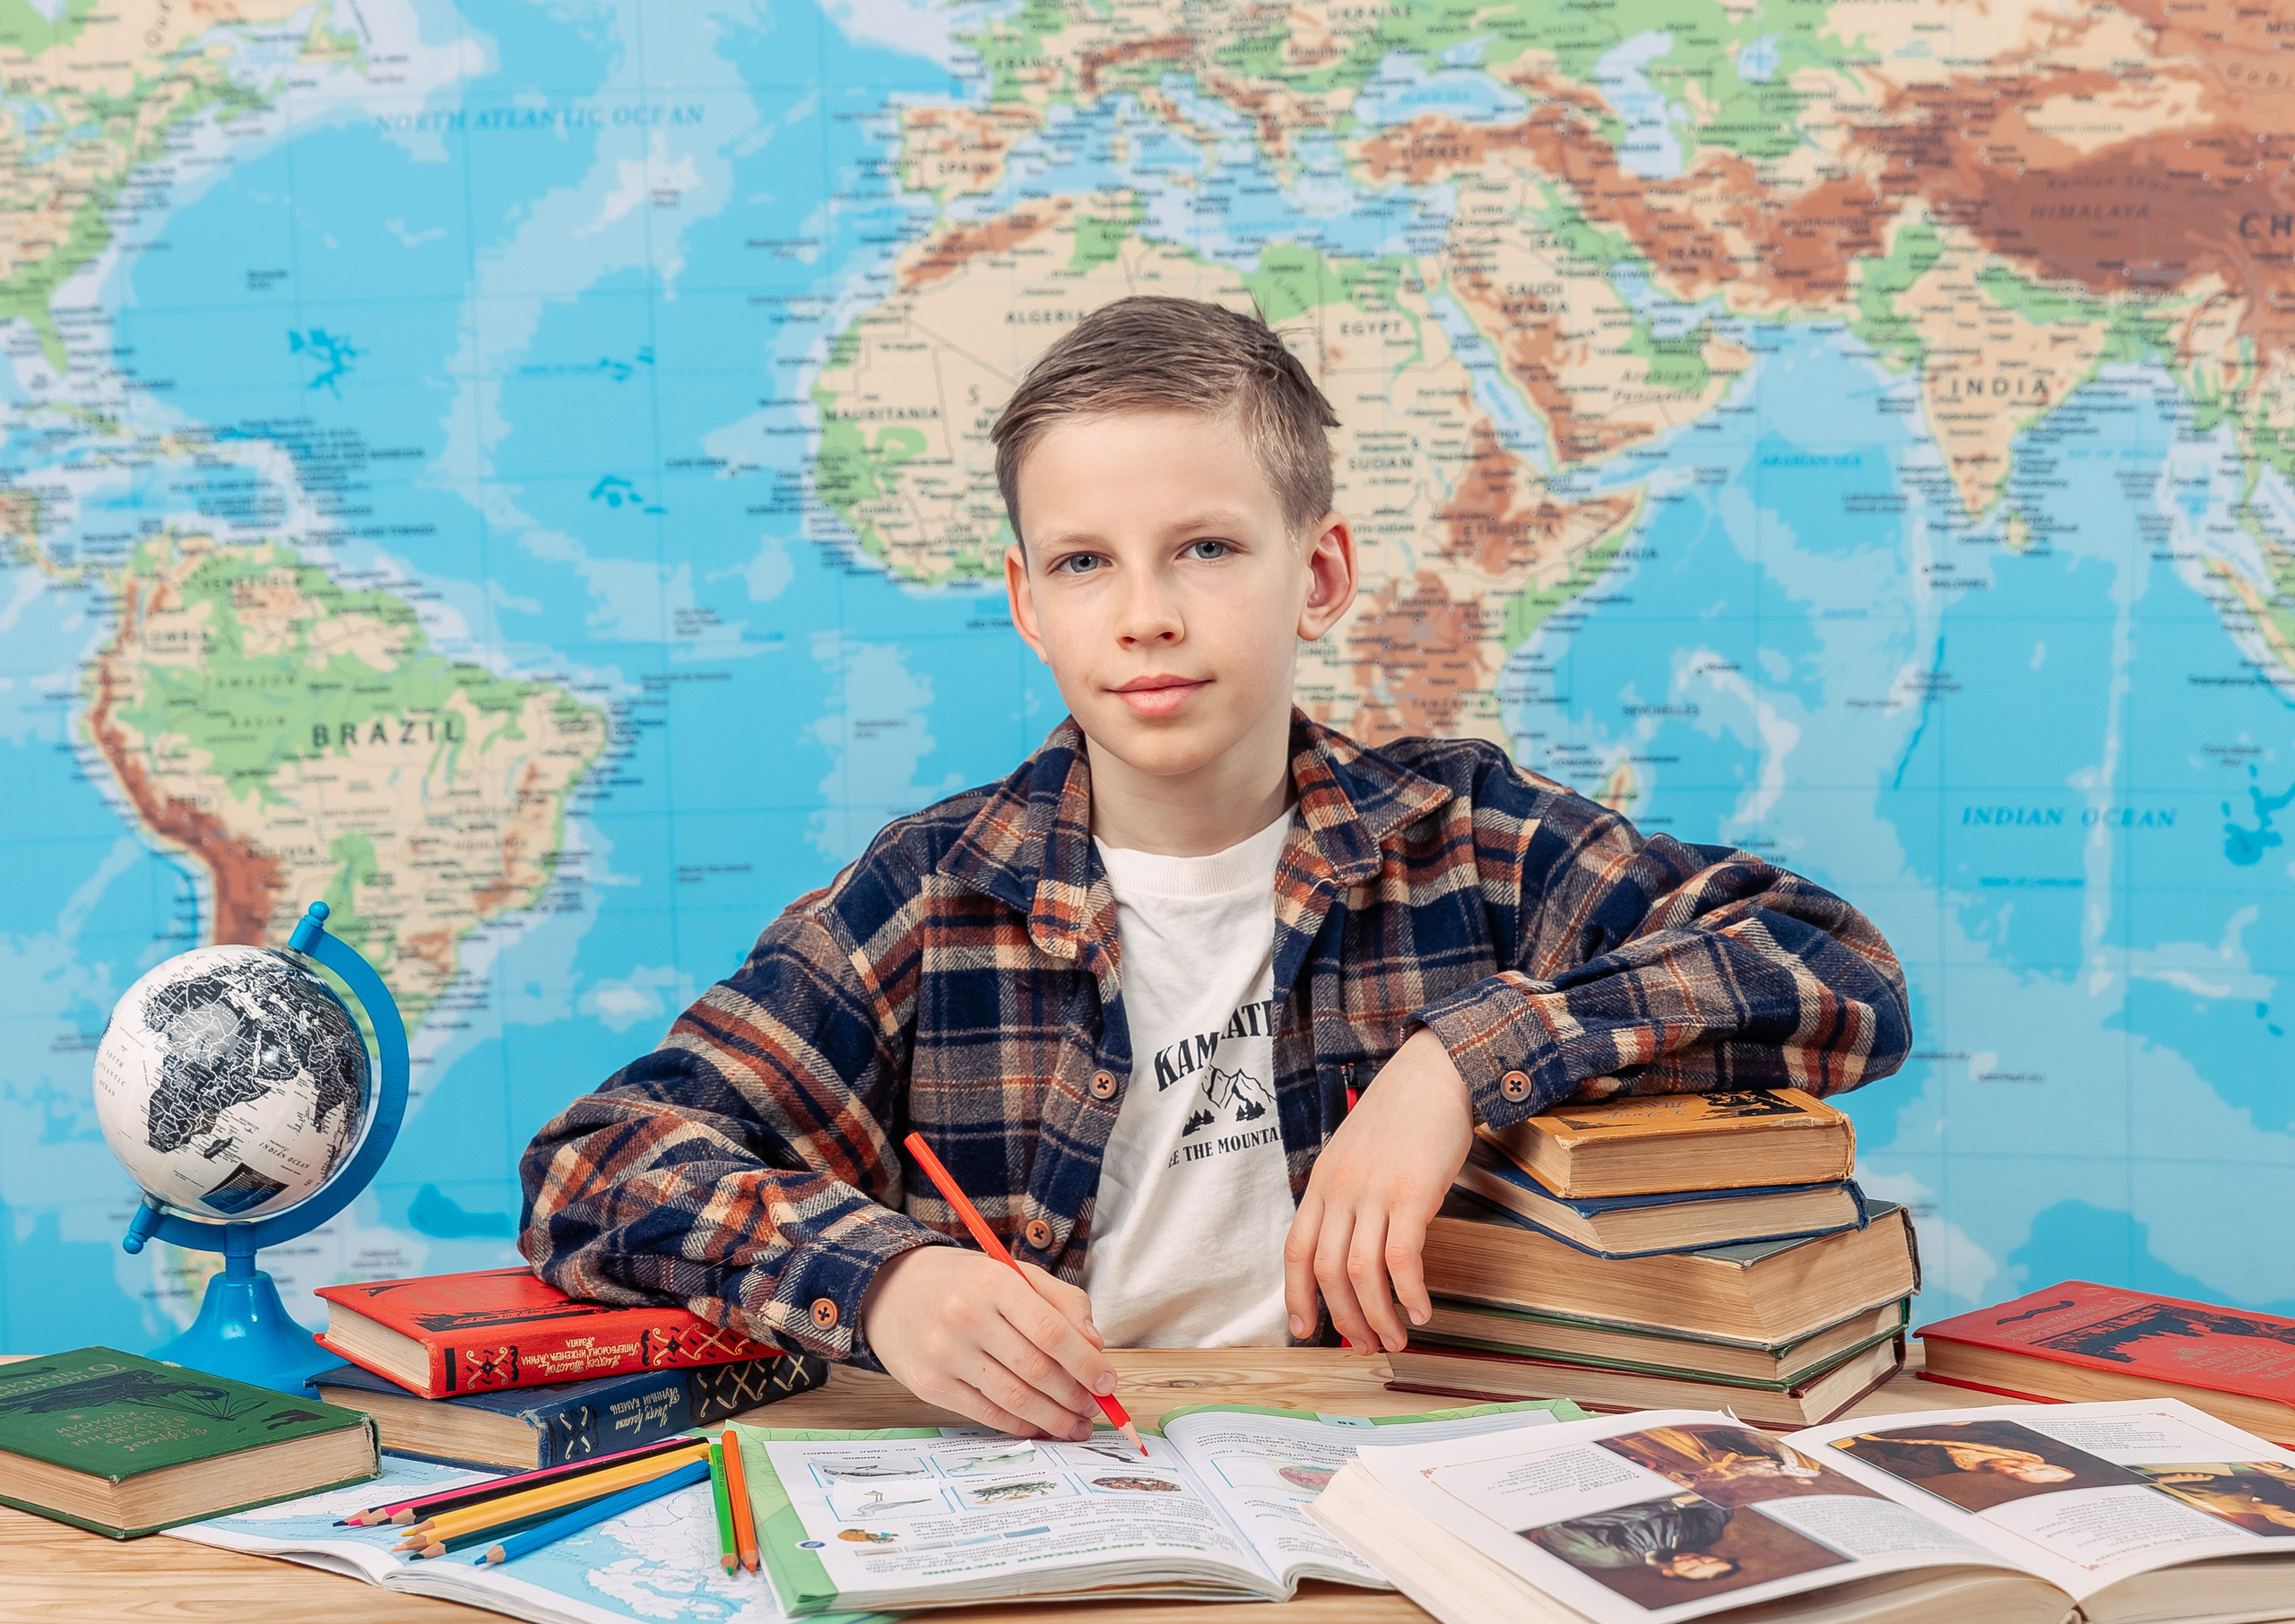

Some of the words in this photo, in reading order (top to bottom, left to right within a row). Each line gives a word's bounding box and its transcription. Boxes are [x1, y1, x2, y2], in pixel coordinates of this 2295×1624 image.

[473, 105, 604, 131] ATLANTIC
[612, 103, 706, 126] OCEAN
[1951, 377, 2048, 396] INDIA
[311, 719, 463, 748] BRAZIL
[1961, 806, 2062, 829] INDIAN
[2081, 807, 2178, 830] OCEAN
[259, 1142, 288, 1160] INDIAN
[287, 1157, 310, 1170] OCEAN
[1182, 1141, 1214, 1162] THE
[1217, 1124, 1283, 1154] MOUNTA
[608, 1398, 641, 1414] КАМЕНЬ
